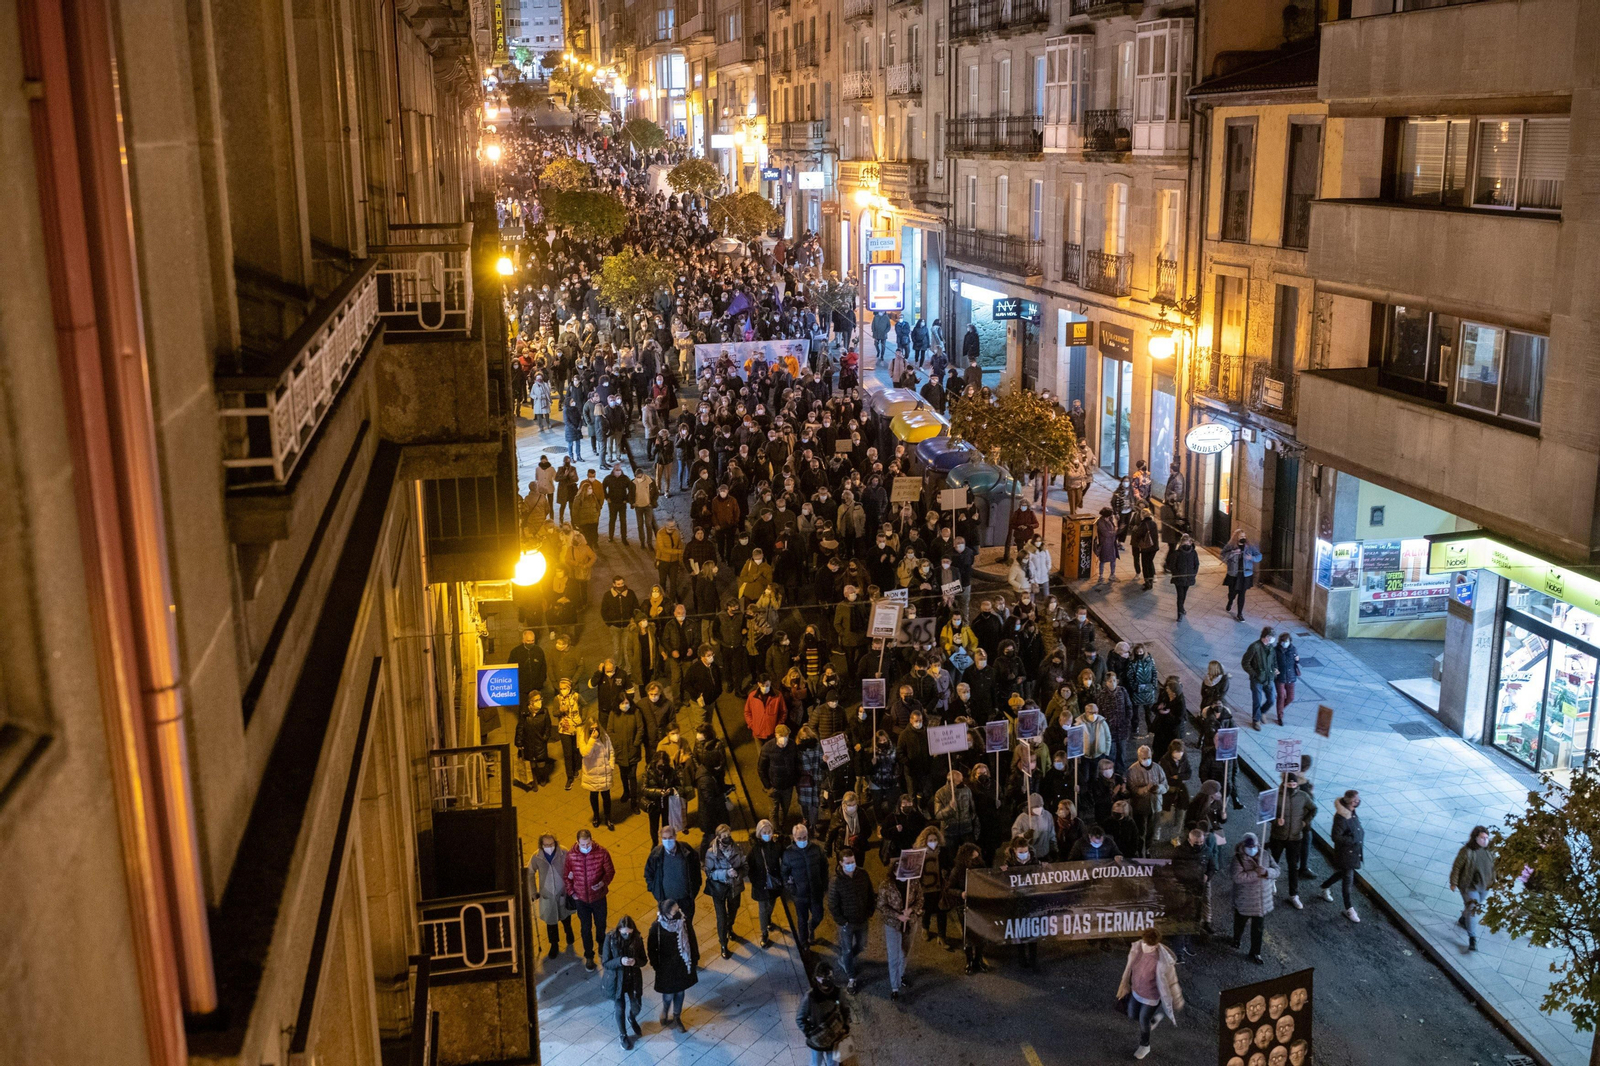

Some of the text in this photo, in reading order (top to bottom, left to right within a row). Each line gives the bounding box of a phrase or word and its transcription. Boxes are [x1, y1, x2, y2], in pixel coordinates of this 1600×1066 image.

[1447, 558, 1467, 567] Nobel
[1385, 580, 1403, 591] -20%
[1546, 581, 1562, 594] Nobel
[1390, 590, 1408, 598] 649
[1410, 589, 1429, 597] 466
[1431, 587, 1450, 596] 719
[900, 619, 934, 645] SOS
[1009, 869, 1089, 888] PLATAFORMA
[1062, 913, 1091, 935] DAS
